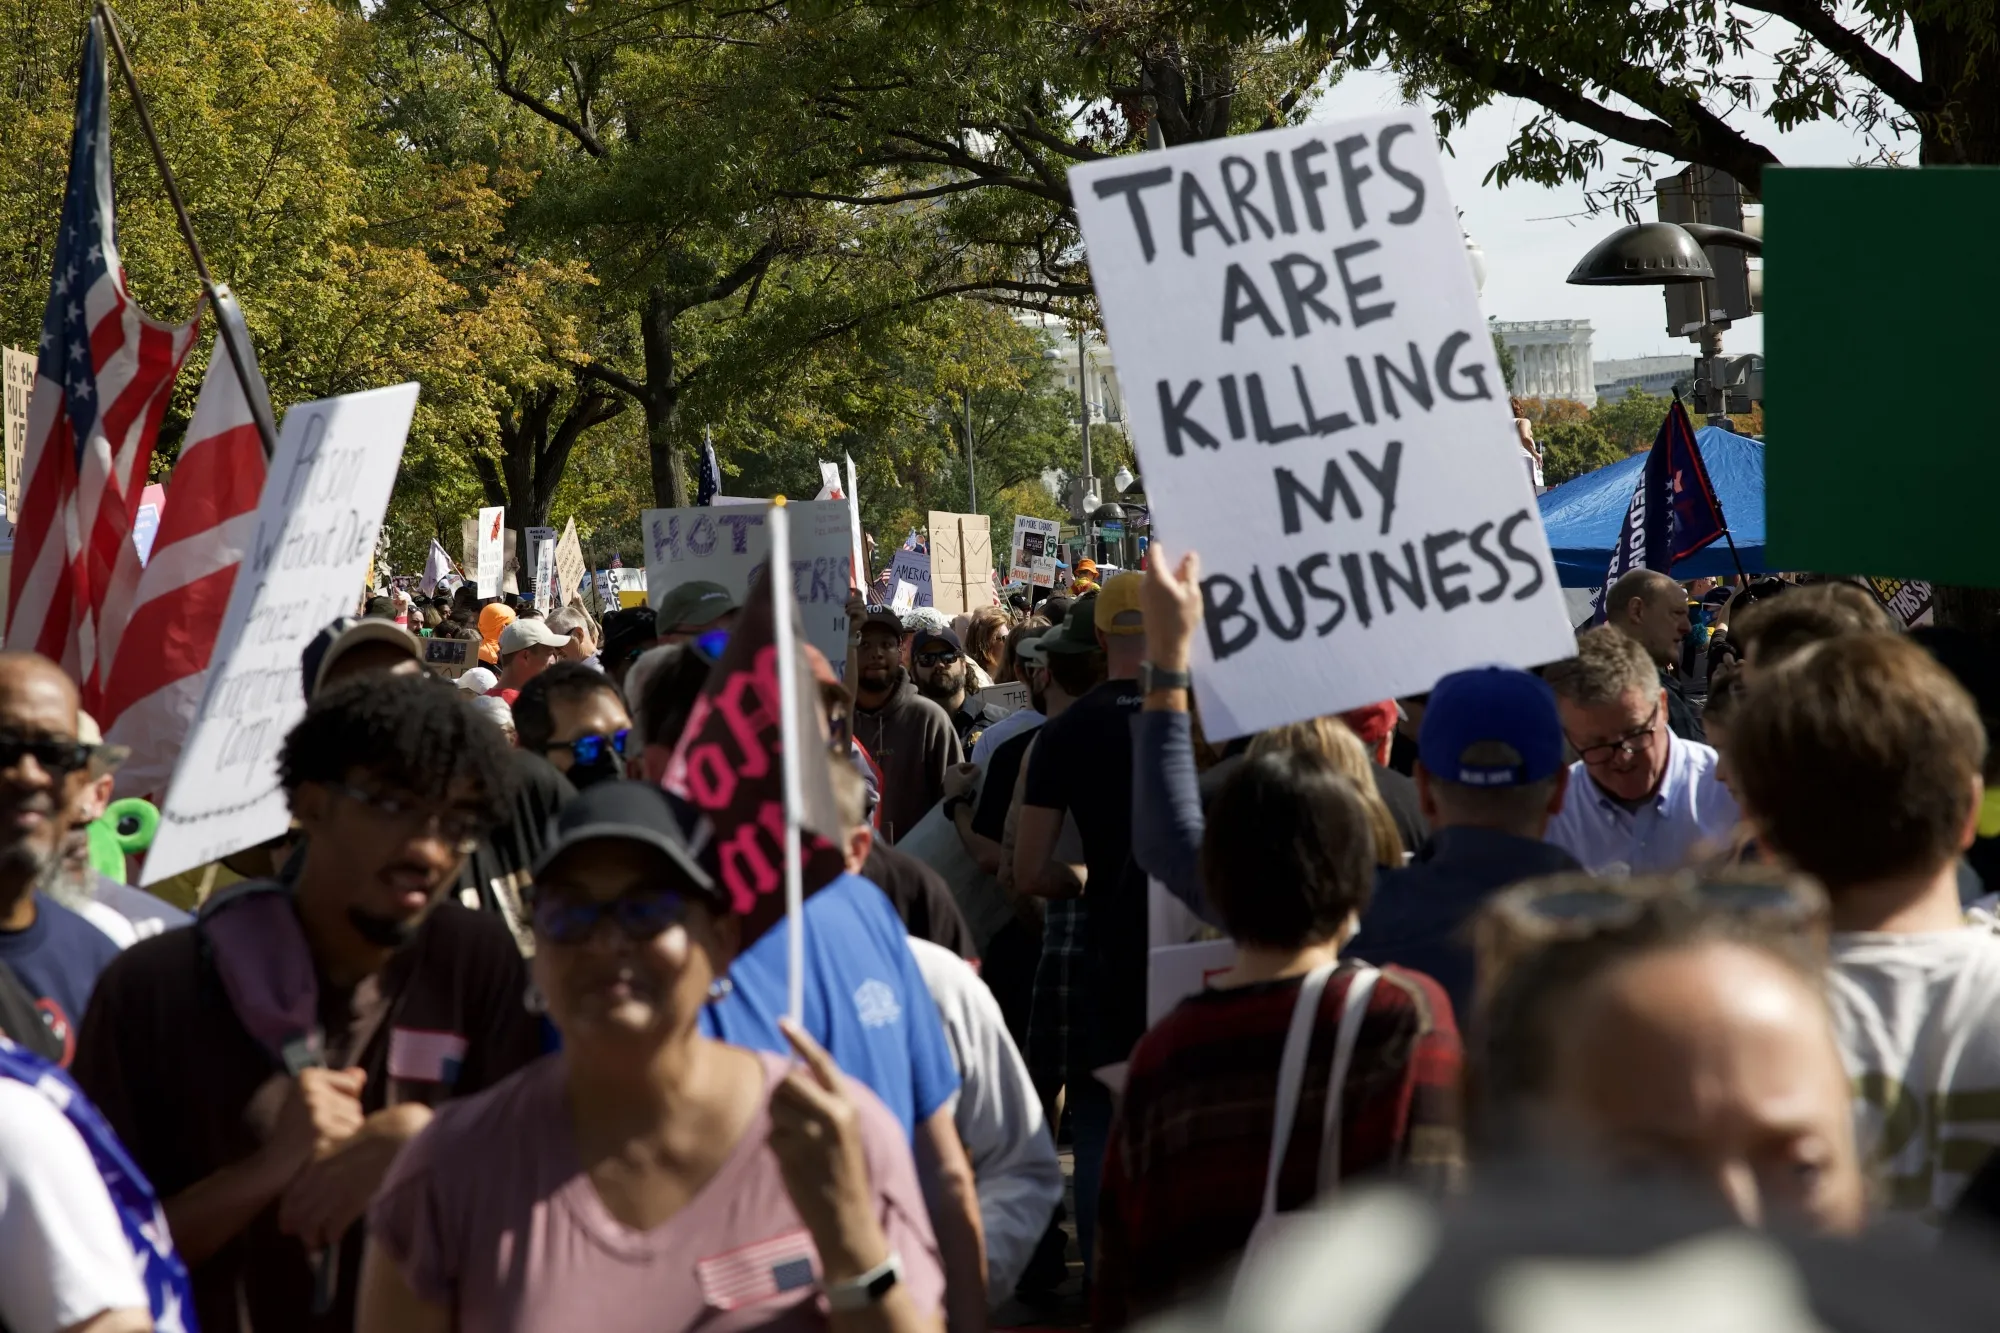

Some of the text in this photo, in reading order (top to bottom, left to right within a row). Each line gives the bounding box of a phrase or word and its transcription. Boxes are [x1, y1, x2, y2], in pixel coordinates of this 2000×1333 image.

[1092, 123, 1426, 264] TARIFFS
[1220, 239, 1396, 343] ARE
[12, 421, 26, 451] OF
[1157, 330, 1492, 457] KILLING
[652, 513, 766, 563] HOT
[1273, 440, 1403, 536] MY
[1199, 509, 1544, 661] BUSINESS
[1887, 584, 1921, 620] THIS
